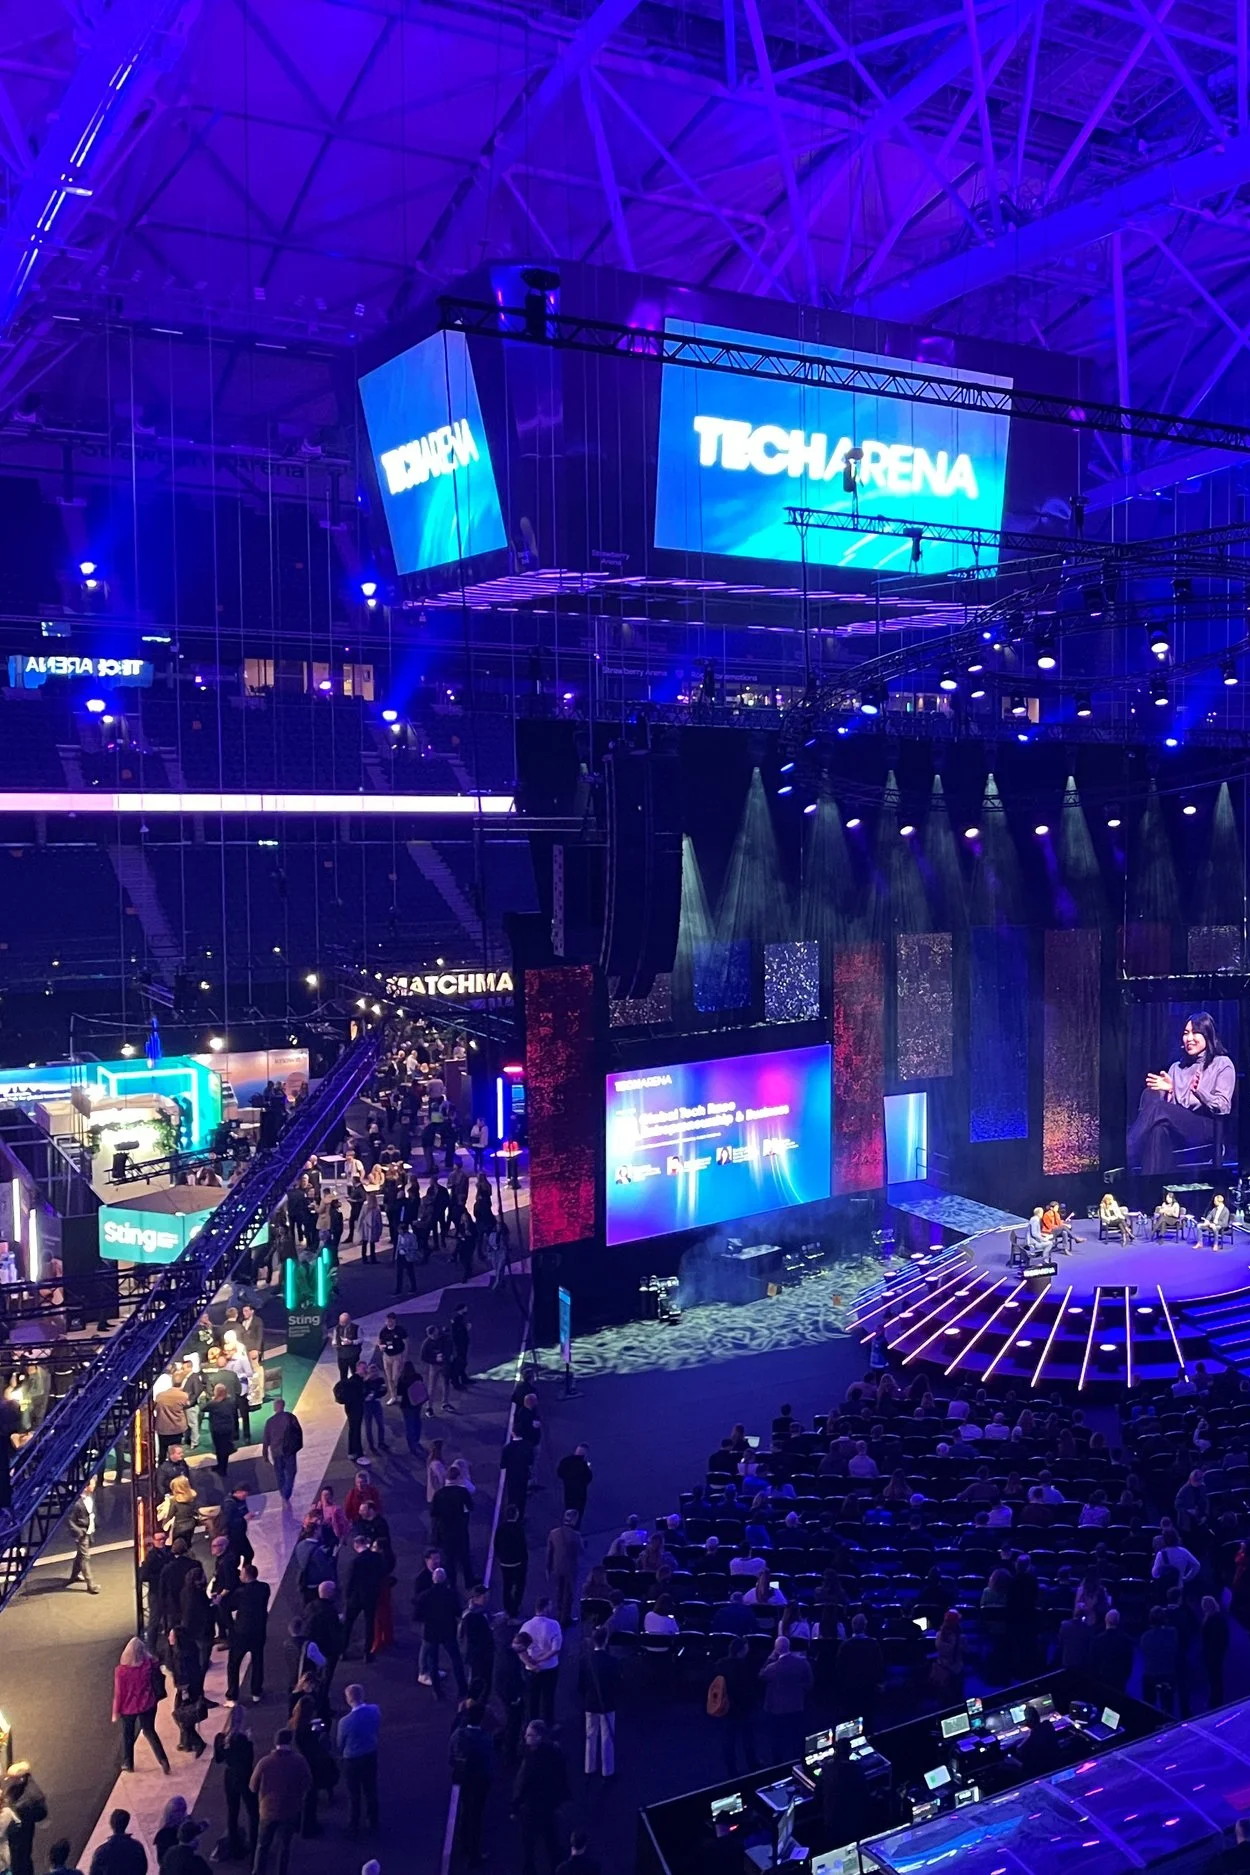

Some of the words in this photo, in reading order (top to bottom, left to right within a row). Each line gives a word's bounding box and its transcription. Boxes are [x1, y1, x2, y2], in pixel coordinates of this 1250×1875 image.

[694, 416, 979, 499] TECHARENA
[104, 1221, 157, 1252] Sting
[288, 1314, 321, 1326] Sting
